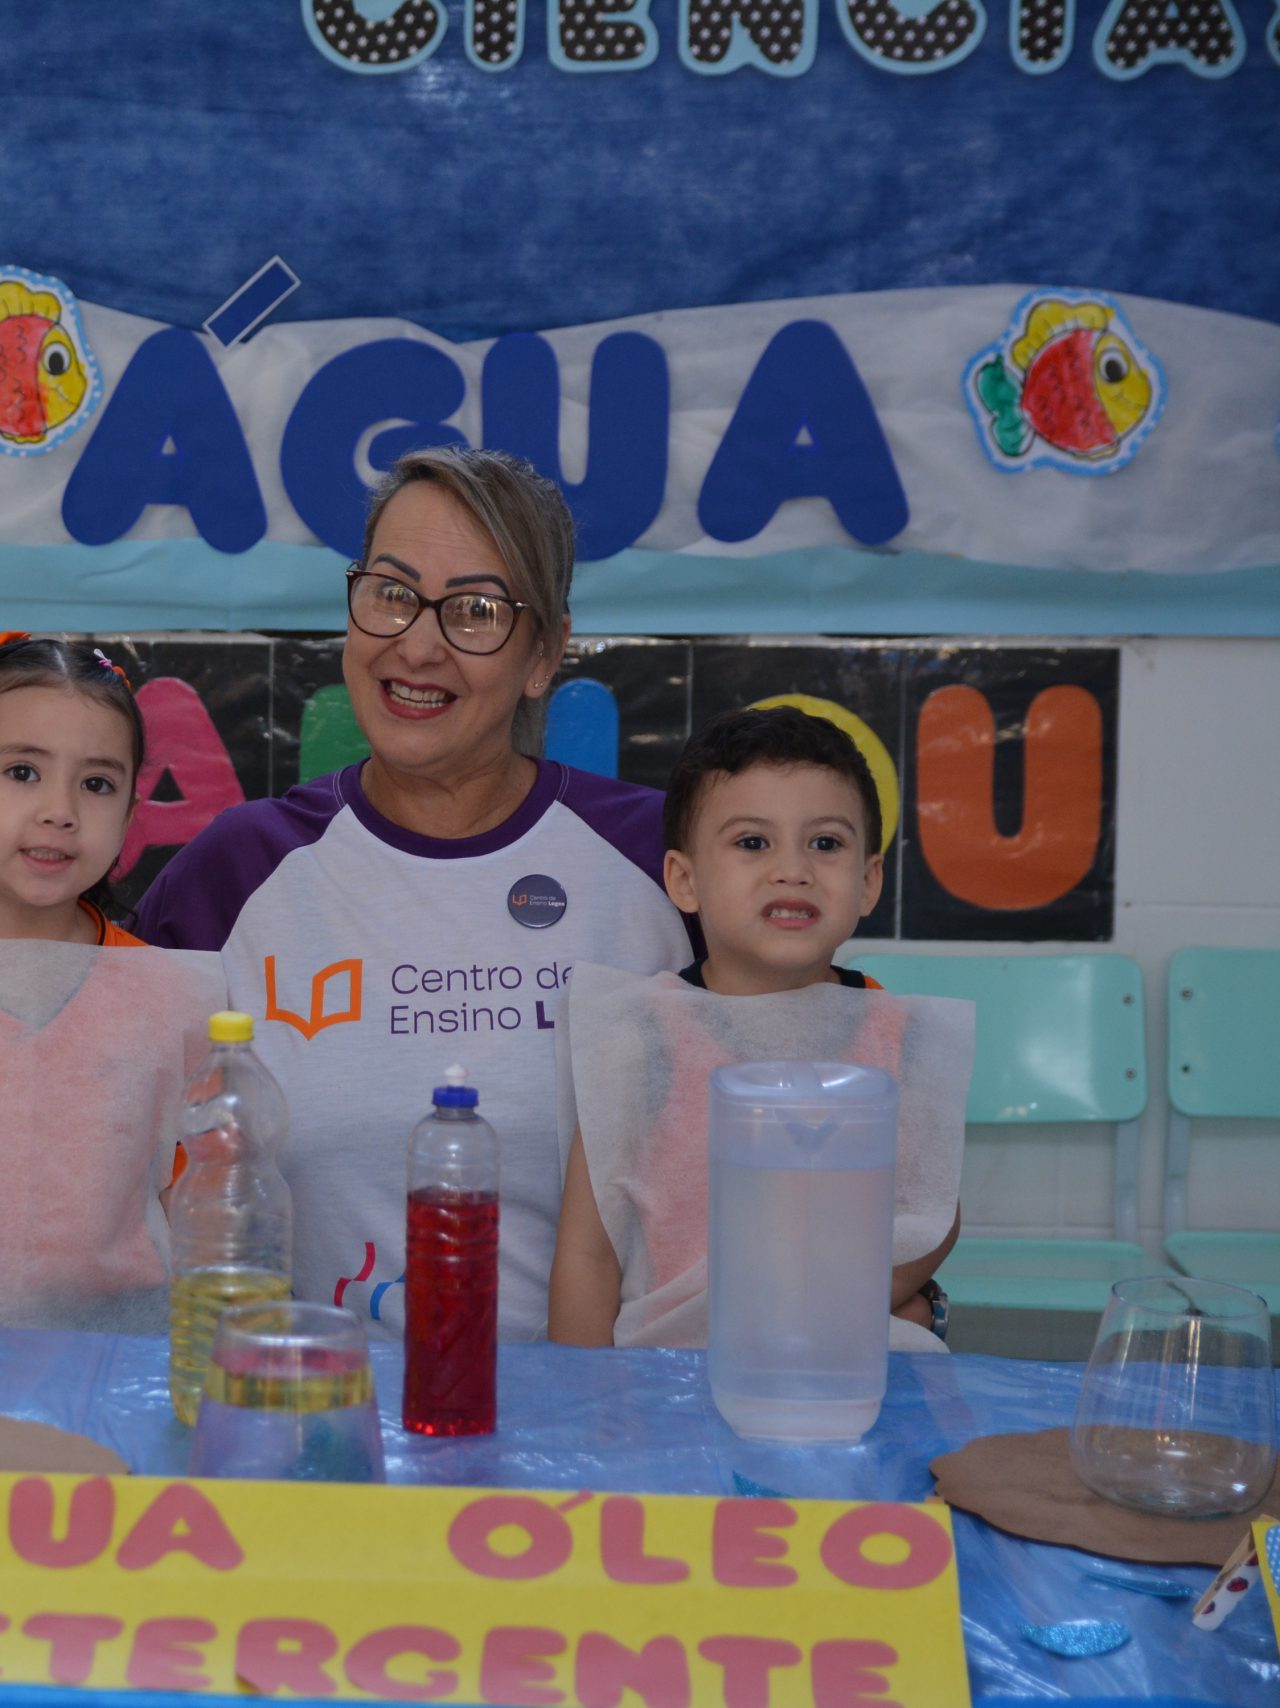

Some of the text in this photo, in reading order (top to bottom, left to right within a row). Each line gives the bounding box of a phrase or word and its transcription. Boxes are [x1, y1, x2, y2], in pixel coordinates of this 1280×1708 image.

[62, 256, 910, 563] ÁGUA
[391, 964, 522, 994] Centro
[390, 1002, 521, 1035] Ensino
[447, 1489, 954, 1590] ÓLEO
